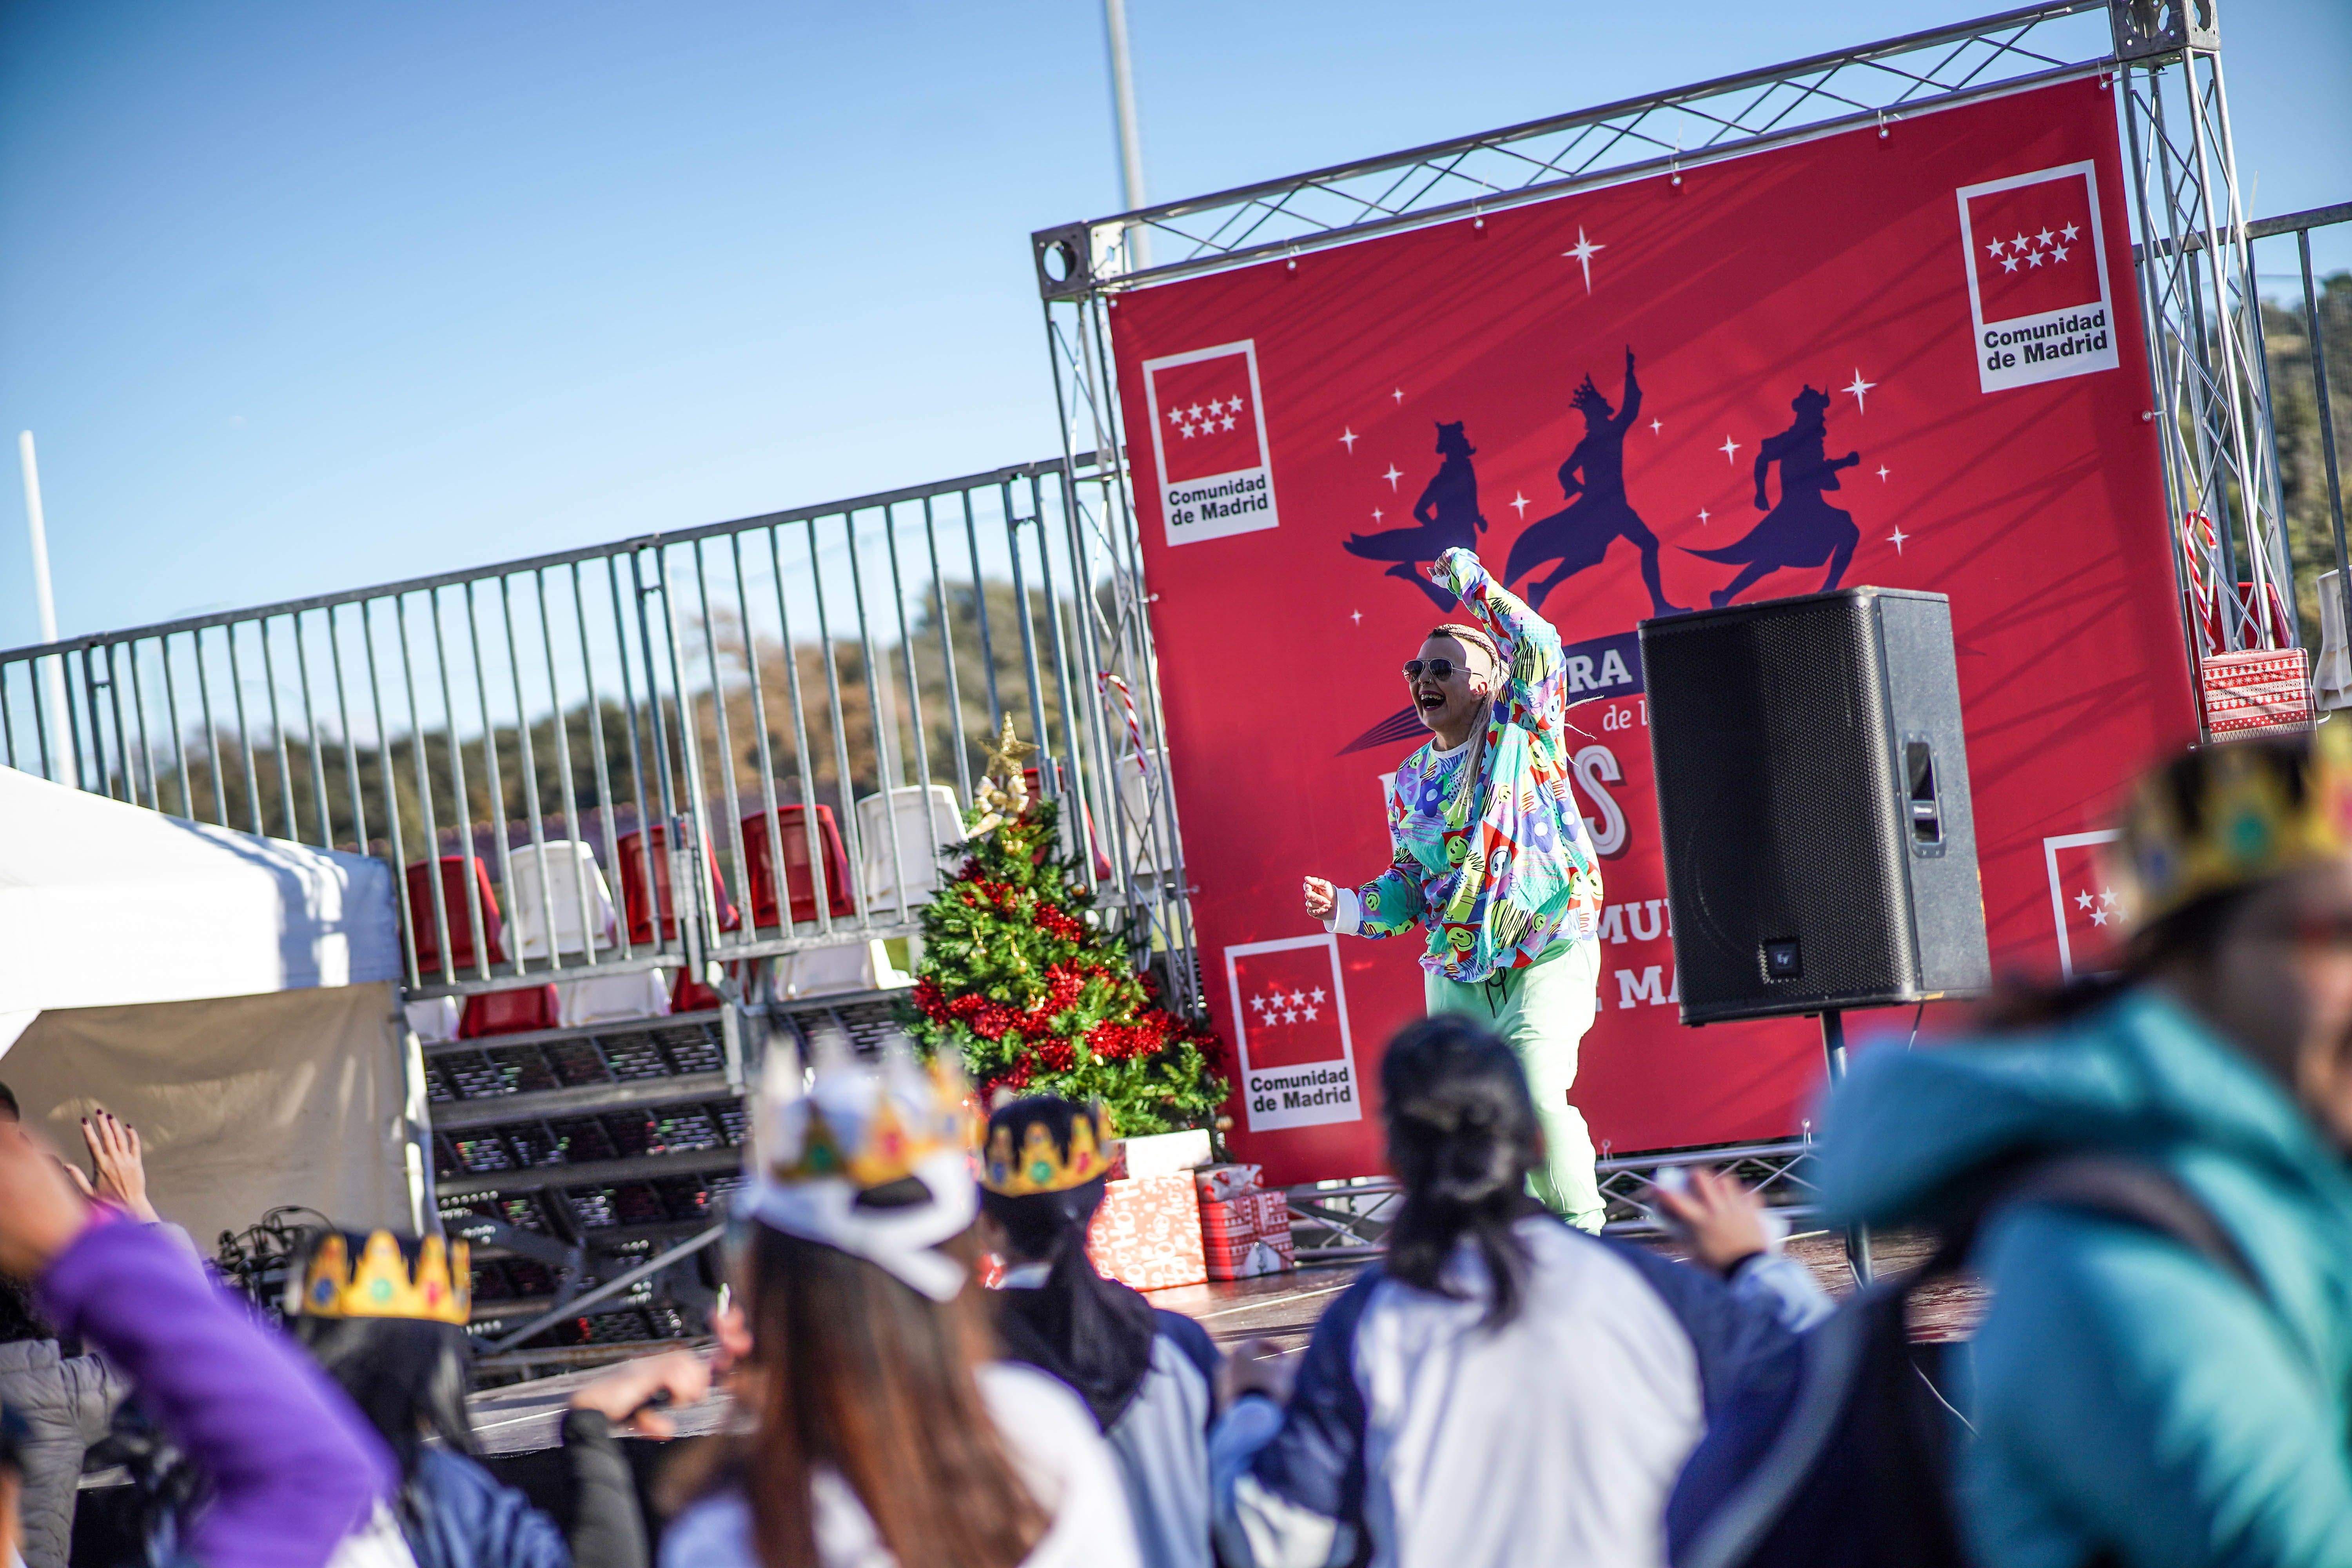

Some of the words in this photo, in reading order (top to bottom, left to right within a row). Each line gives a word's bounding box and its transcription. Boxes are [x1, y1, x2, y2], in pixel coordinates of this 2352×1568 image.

[1984, 309, 2105, 348] Comunidad
[1987, 350, 2015, 370] de
[2023, 329, 2108, 364] Madrid
[1169, 474, 1266, 505] Comunidad
[1172, 508, 1194, 526] de
[1201, 492, 1268, 521] Madrid
[1566, 648, 1633, 693] RA
[1603, 704, 1632, 731] de
[1250, 1066, 1349, 1093] Comunidad
[1253, 1095, 1277, 1112] de
[1283, 1085, 1352, 1109] Madrid
